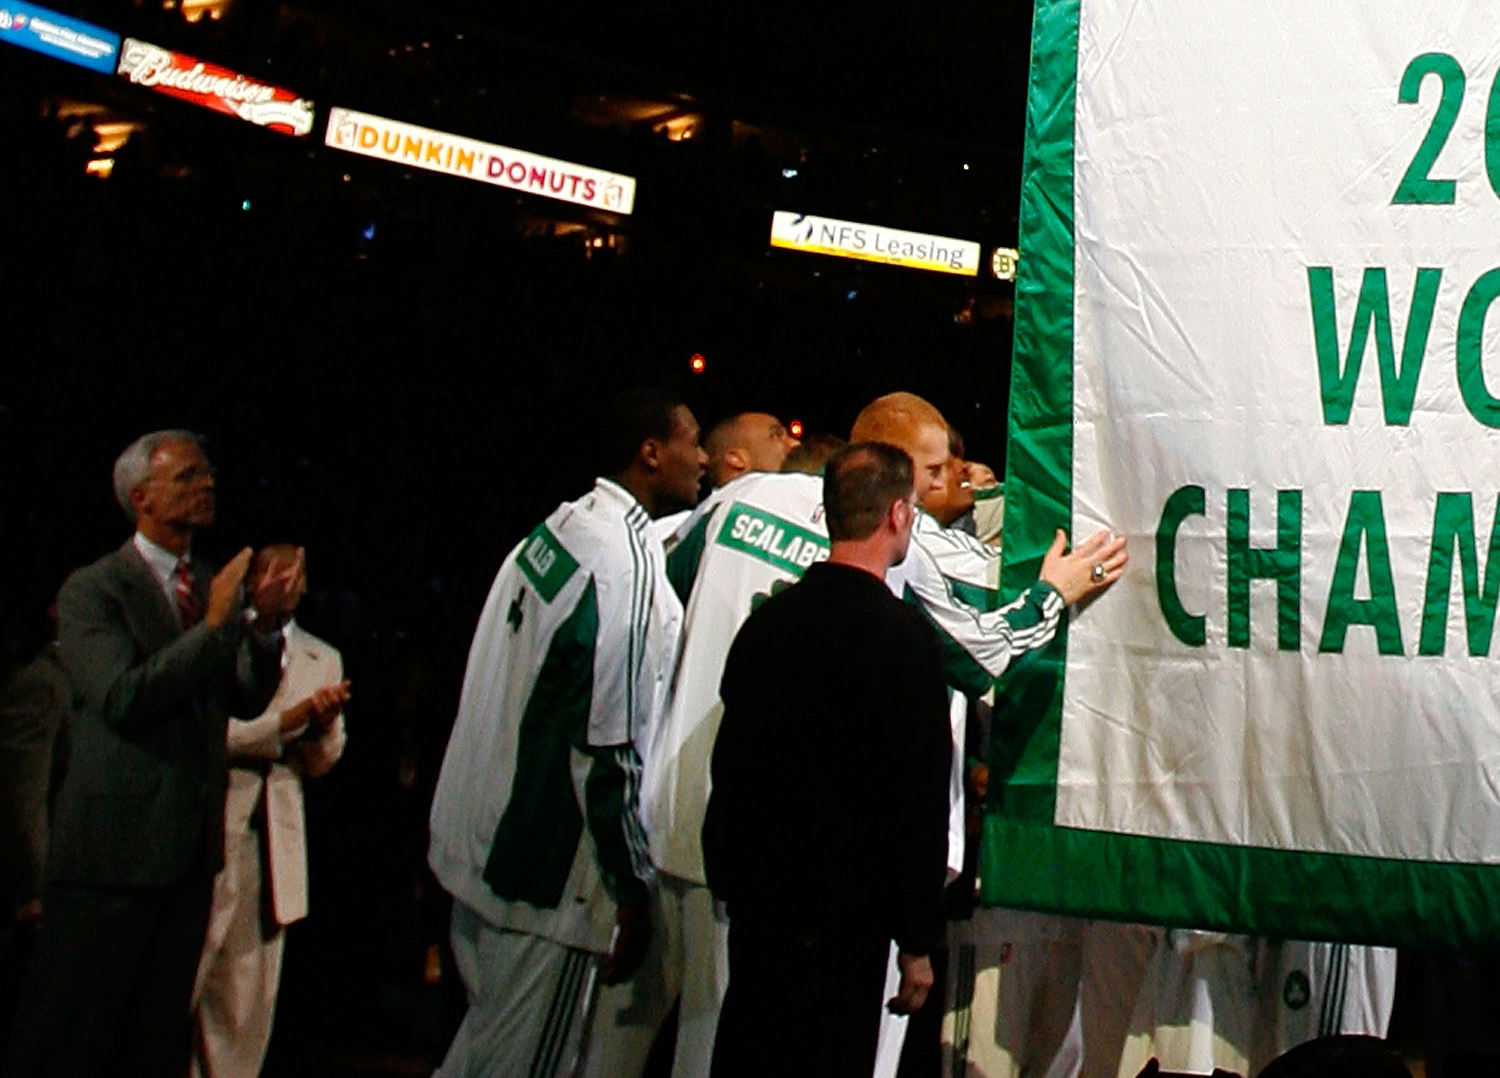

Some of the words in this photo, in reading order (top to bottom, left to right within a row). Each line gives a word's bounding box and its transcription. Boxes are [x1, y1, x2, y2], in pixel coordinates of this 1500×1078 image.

[128, 44, 275, 103] Budweiser
[358, 125, 484, 174] DUNKIN'
[486, 155, 597, 201] DONUTS
[819, 224, 867, 250] NFS
[874, 233, 966, 270] Leasing
